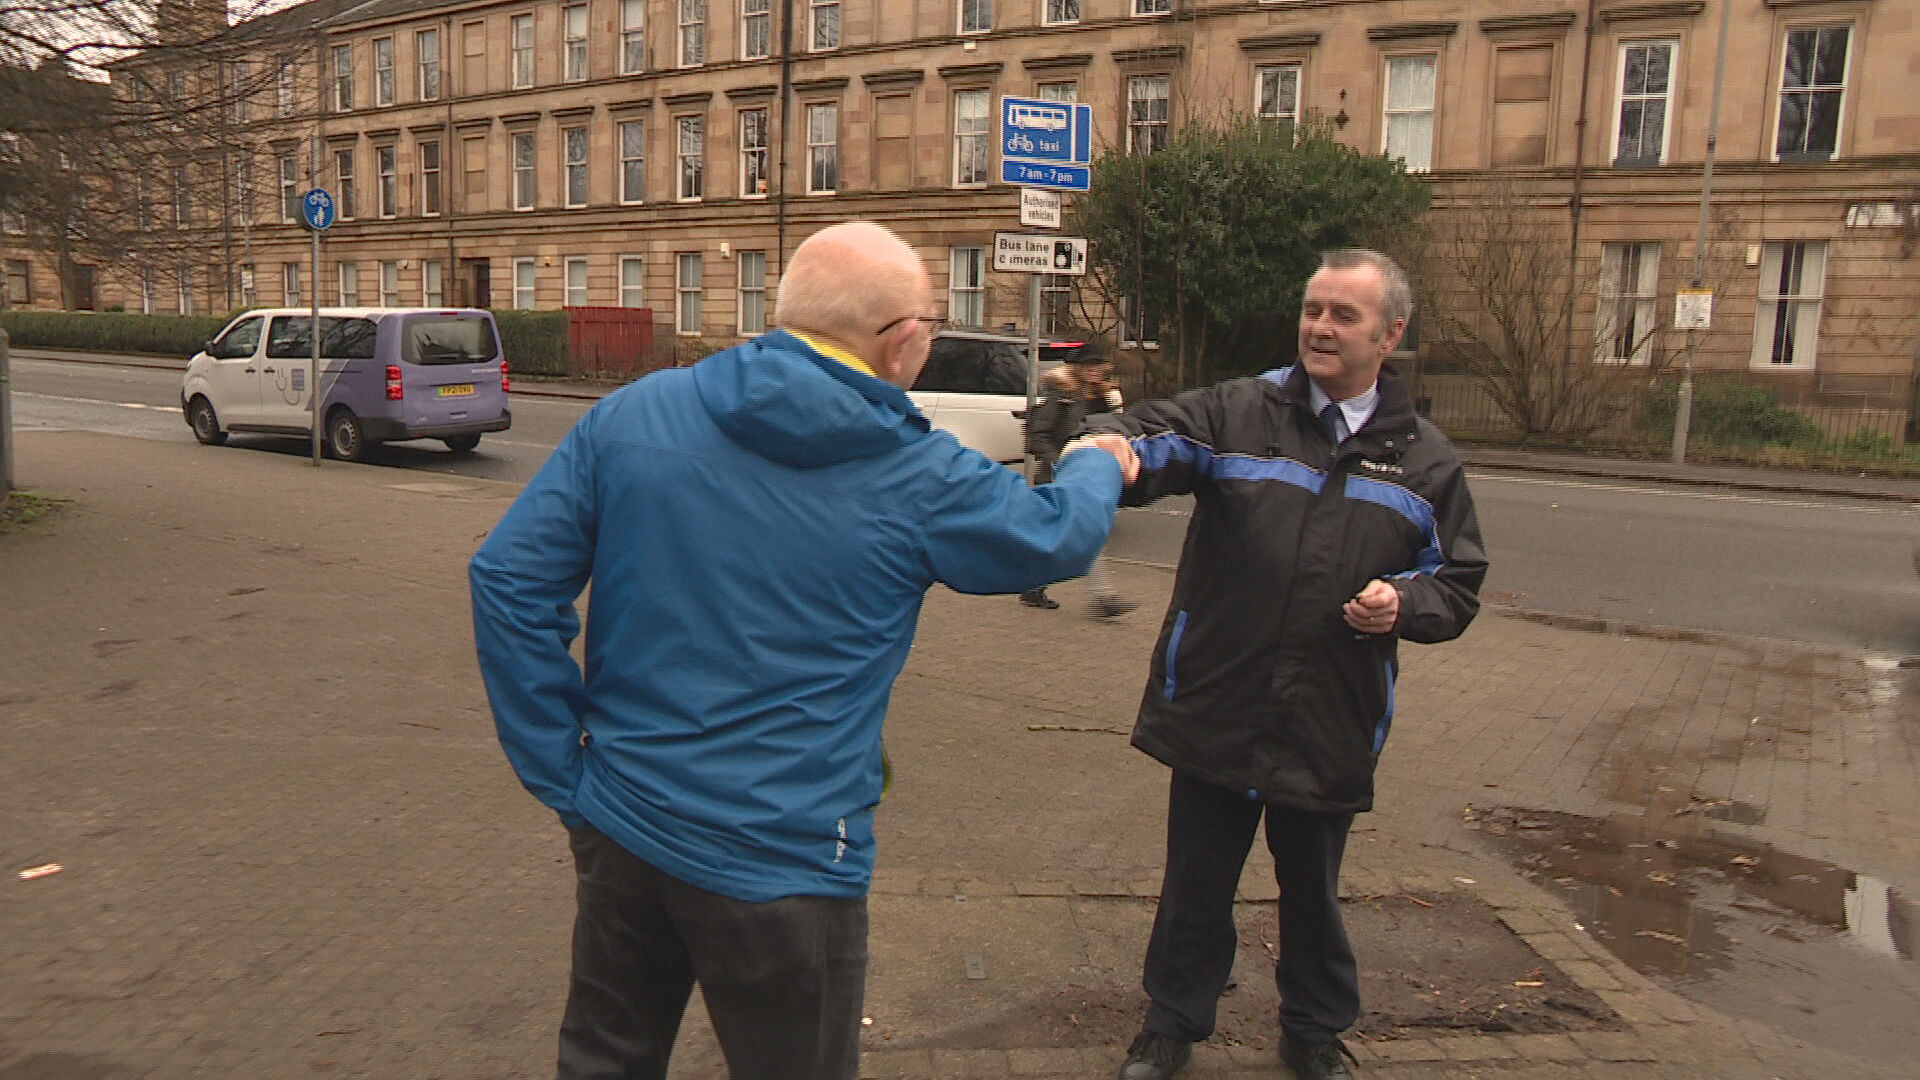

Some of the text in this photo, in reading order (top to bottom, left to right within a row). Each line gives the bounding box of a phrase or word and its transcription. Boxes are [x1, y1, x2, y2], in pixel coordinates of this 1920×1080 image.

[1039, 140, 1060, 151] taxi
[1023, 194, 1059, 209] Authorised
[1028, 209, 1055, 222] vehicles
[999, 238, 1050, 253] Bus lane
